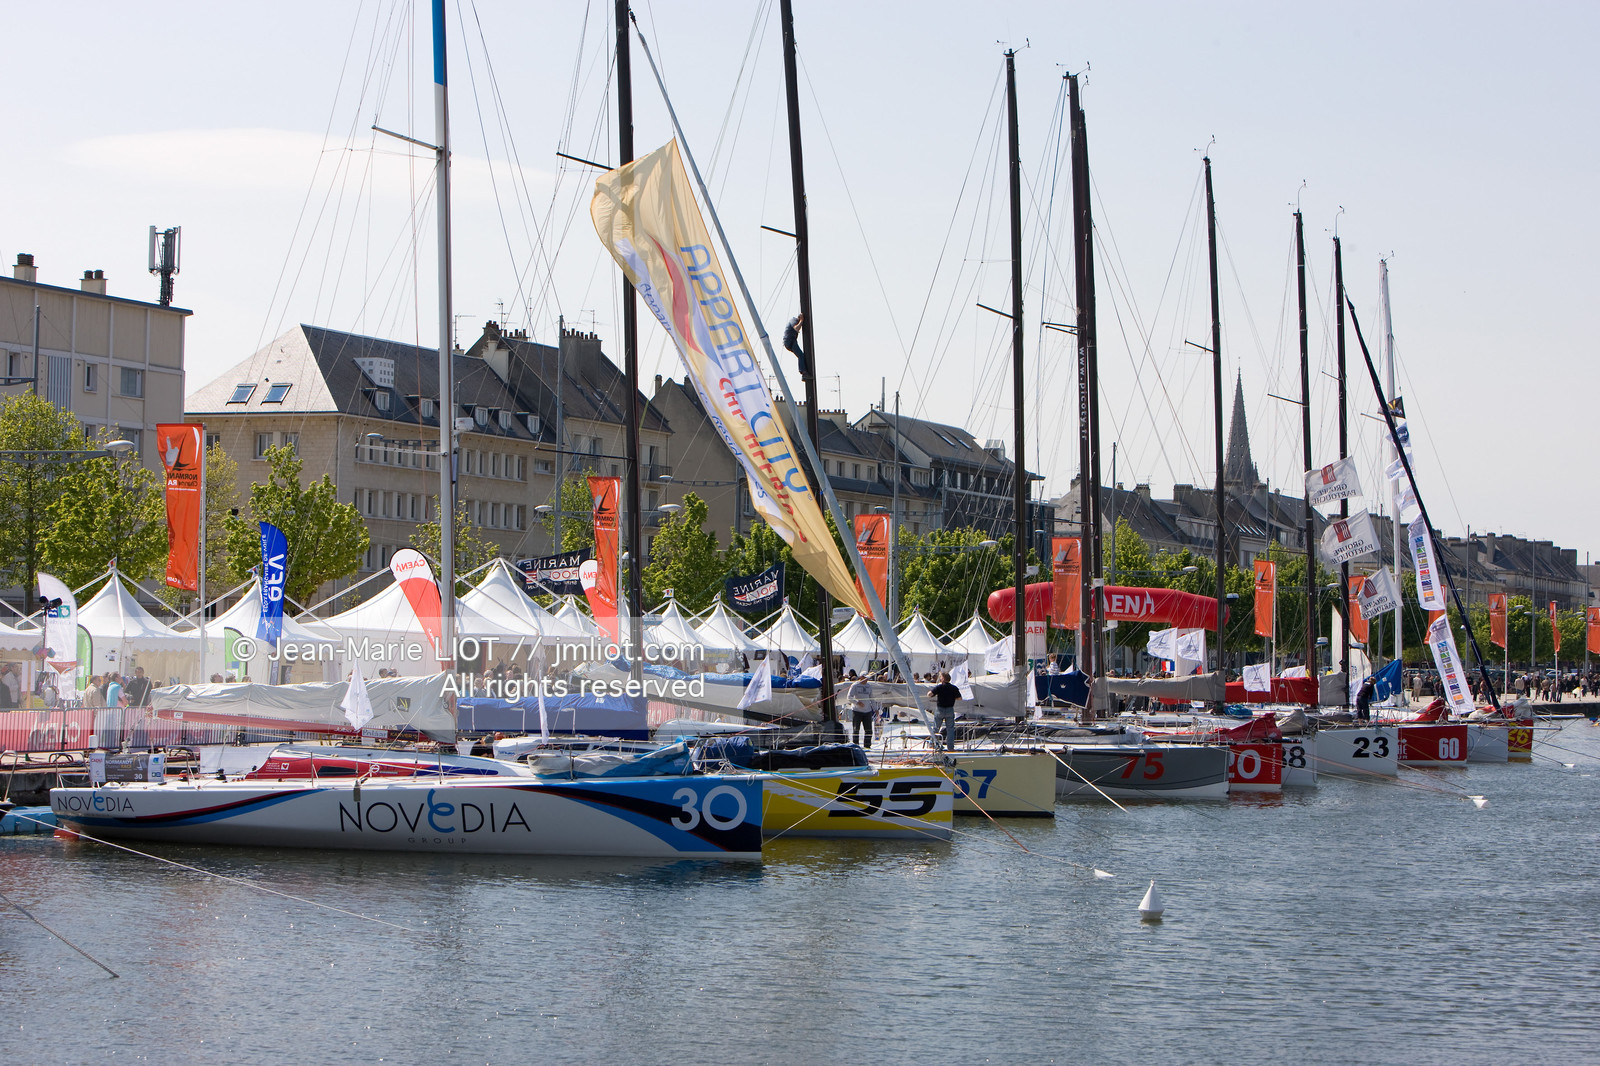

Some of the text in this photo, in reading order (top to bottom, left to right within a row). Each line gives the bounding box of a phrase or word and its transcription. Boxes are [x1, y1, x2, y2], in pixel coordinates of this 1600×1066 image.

[1078, 346, 1088, 441] www.picoty.fr
[1091, 594, 1136, 614] AEN
[1352, 736, 1390, 759] 23
[1438, 737, 1460, 760] 60
[1120, 751, 1165, 780] 75
[828, 780, 942, 818] 55
[953, 769, 998, 800] 67
[670, 784, 747, 832] 30
[407, 836, 467, 845] GROUP
